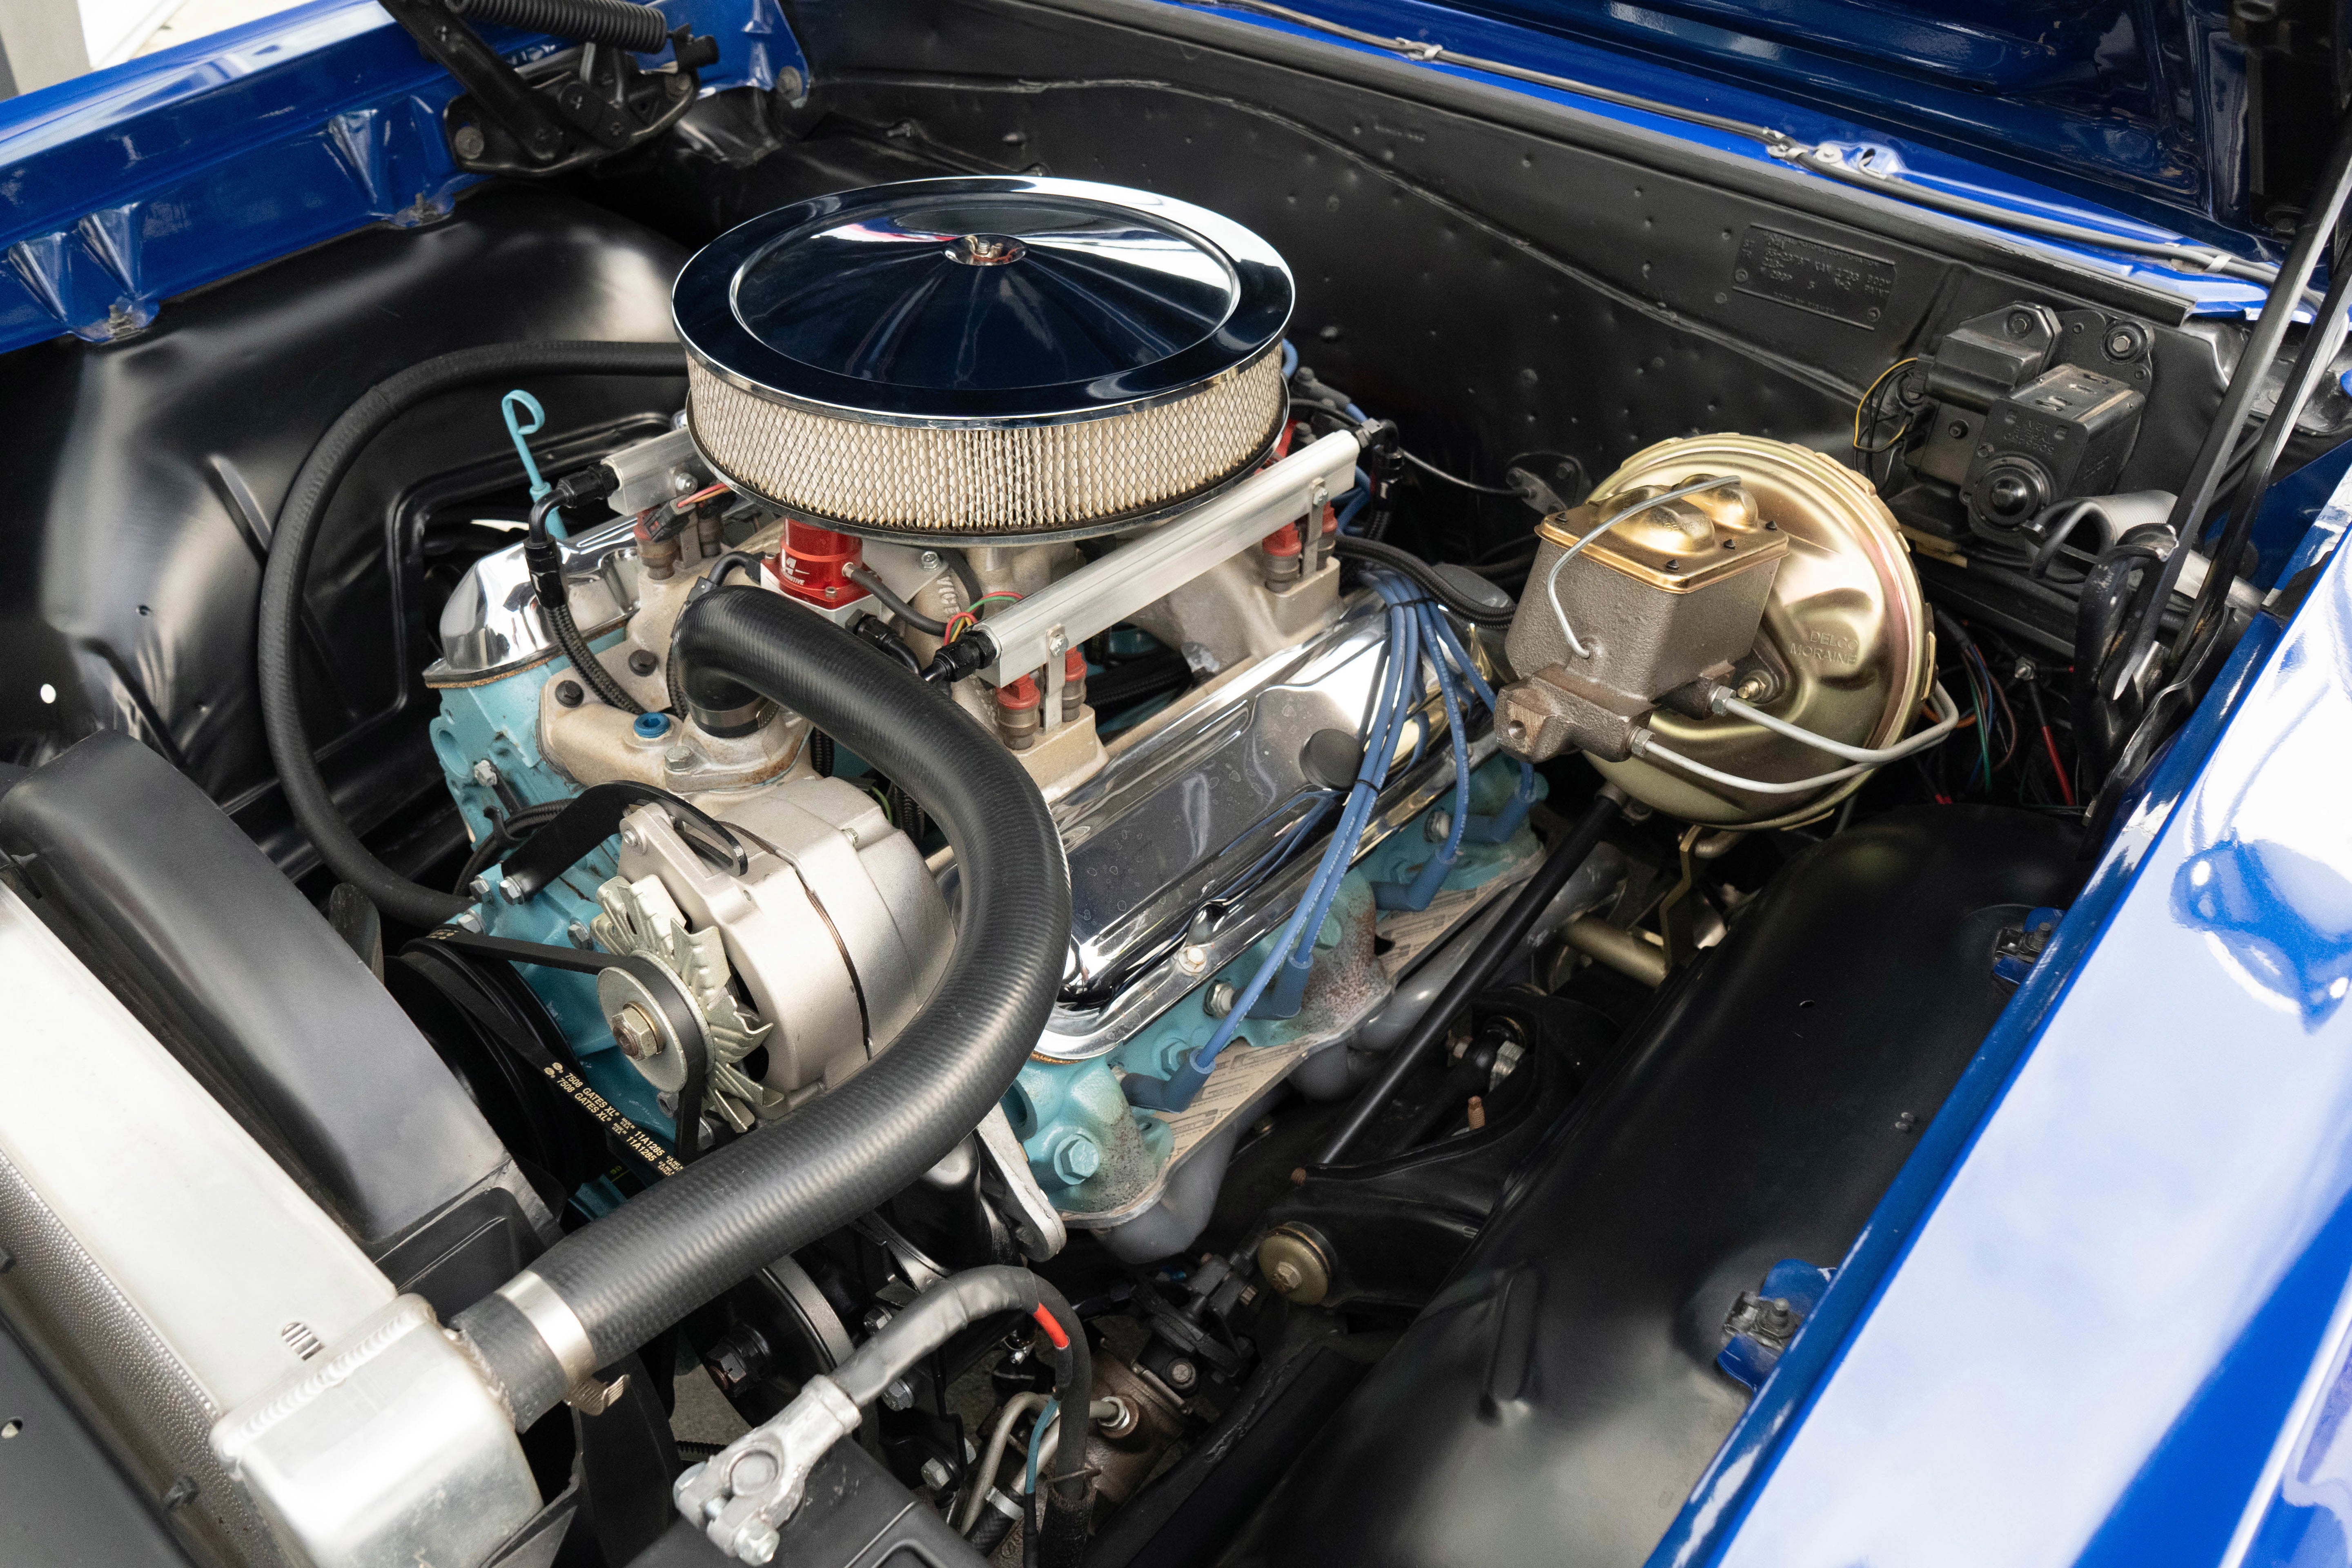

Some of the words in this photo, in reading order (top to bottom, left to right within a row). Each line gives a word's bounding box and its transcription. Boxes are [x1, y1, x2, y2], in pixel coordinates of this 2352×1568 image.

[1425, 624, 1436, 643] CORE
[1809, 630, 1859, 651] DELCO
[1433, 646, 1450, 682] RESISTOR
[1790, 642, 1857, 667] MORAINE
[1447, 687, 1462, 724] SILICONE
[1309, 877, 1327, 913] SILICONE
[1327, 839, 1346, 875] RESISTOR
[1345, 816, 1356, 837] CORE
[557, 1078, 575, 1092] 7508
[575, 1093, 599, 1113] GATES
[565, 1073, 583, 1087] 7508
[582, 1088, 608, 1108] GATES
[613, 1123, 624, 1131] MADE
[621, 1117, 632, 1126] MADE
[626, 1136, 657, 1161] 11A1285
[634, 1131, 666, 1156] 11A1285
